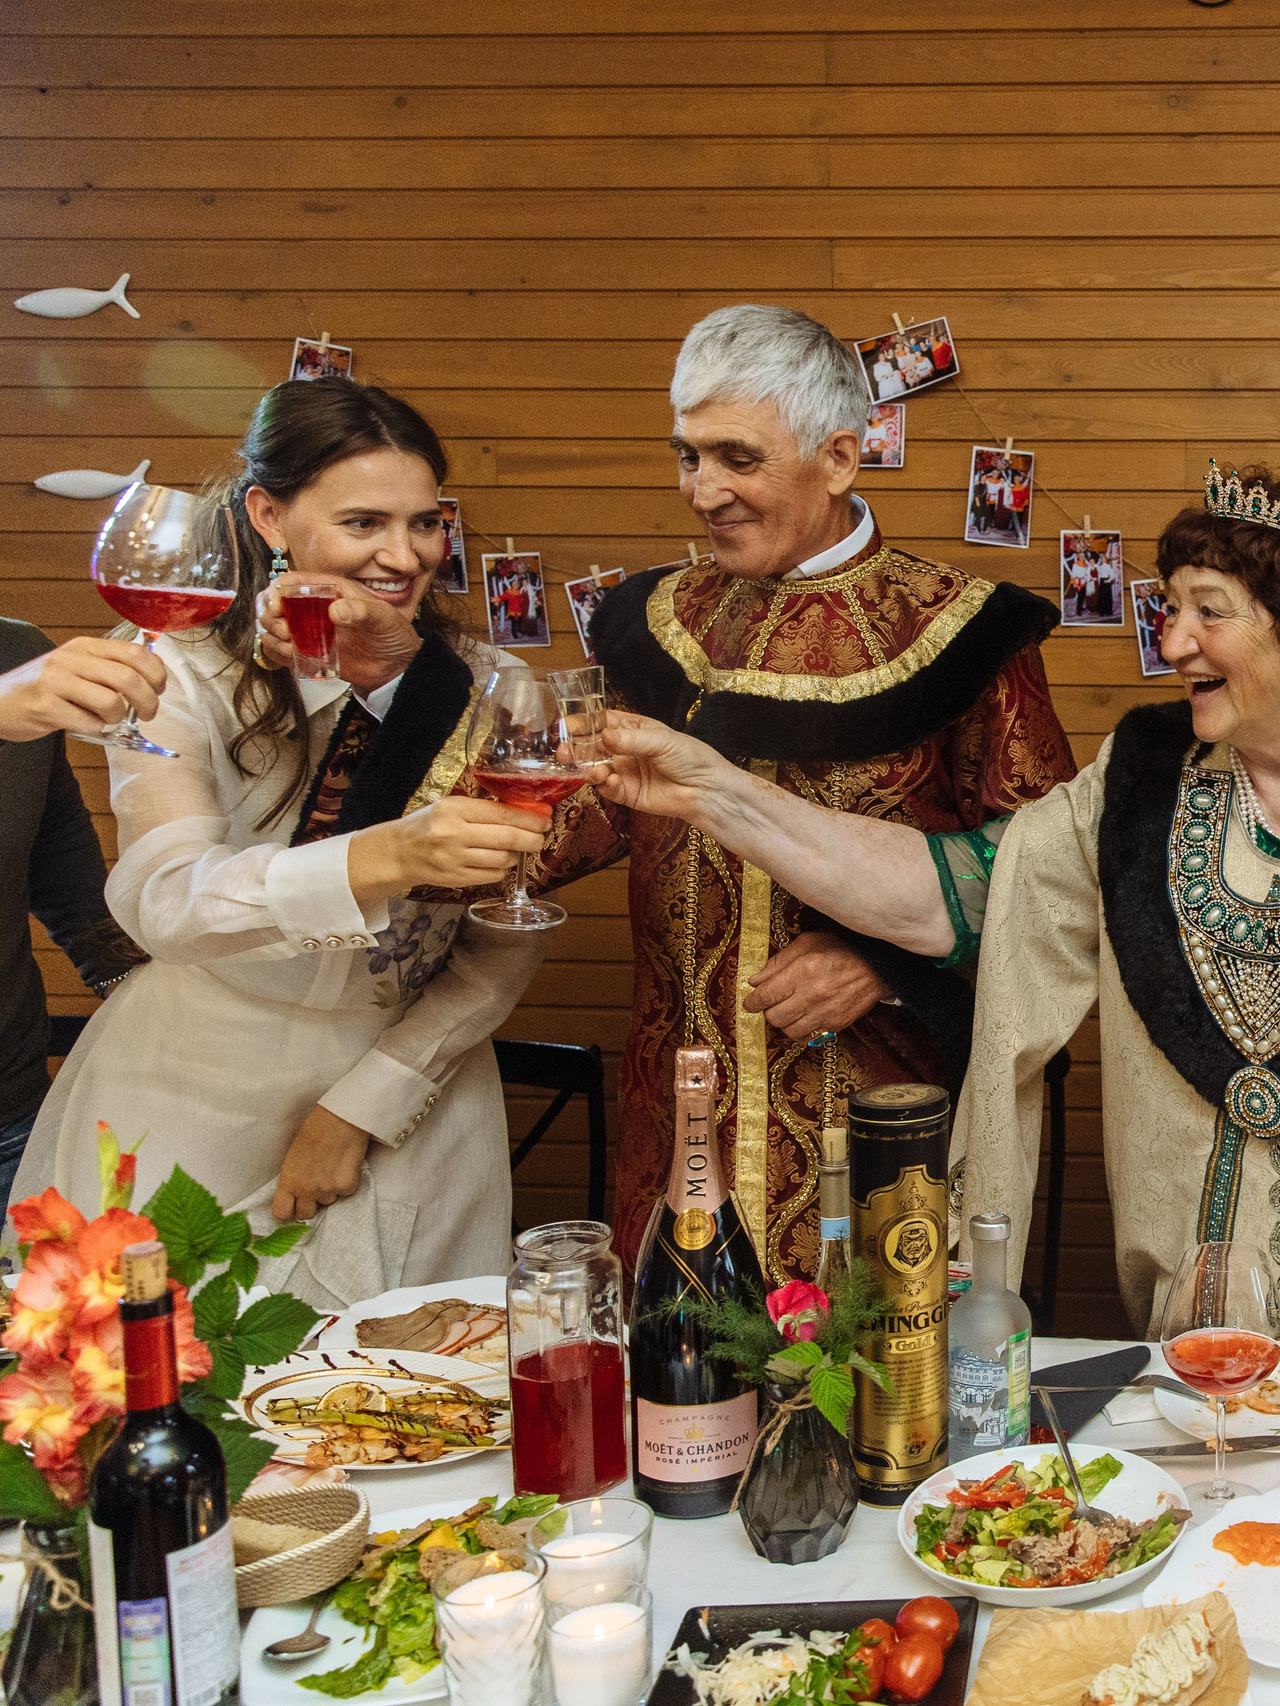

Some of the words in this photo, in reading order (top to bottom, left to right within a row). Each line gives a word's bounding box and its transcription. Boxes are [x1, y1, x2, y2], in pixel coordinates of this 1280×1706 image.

[686, 1112, 708, 1197] MOËT
[895, 1335, 932, 1352] Gold
[660, 1414, 731, 1426] CHAMPAGNE
[645, 1440, 674, 1456] MOËT
[676, 1447, 684, 1456] &
[687, 1432, 750, 1456] CHANDON
[656, 1456, 681, 1465] ROSÉ
[686, 1451, 738, 1464] IMPÉRIAL
